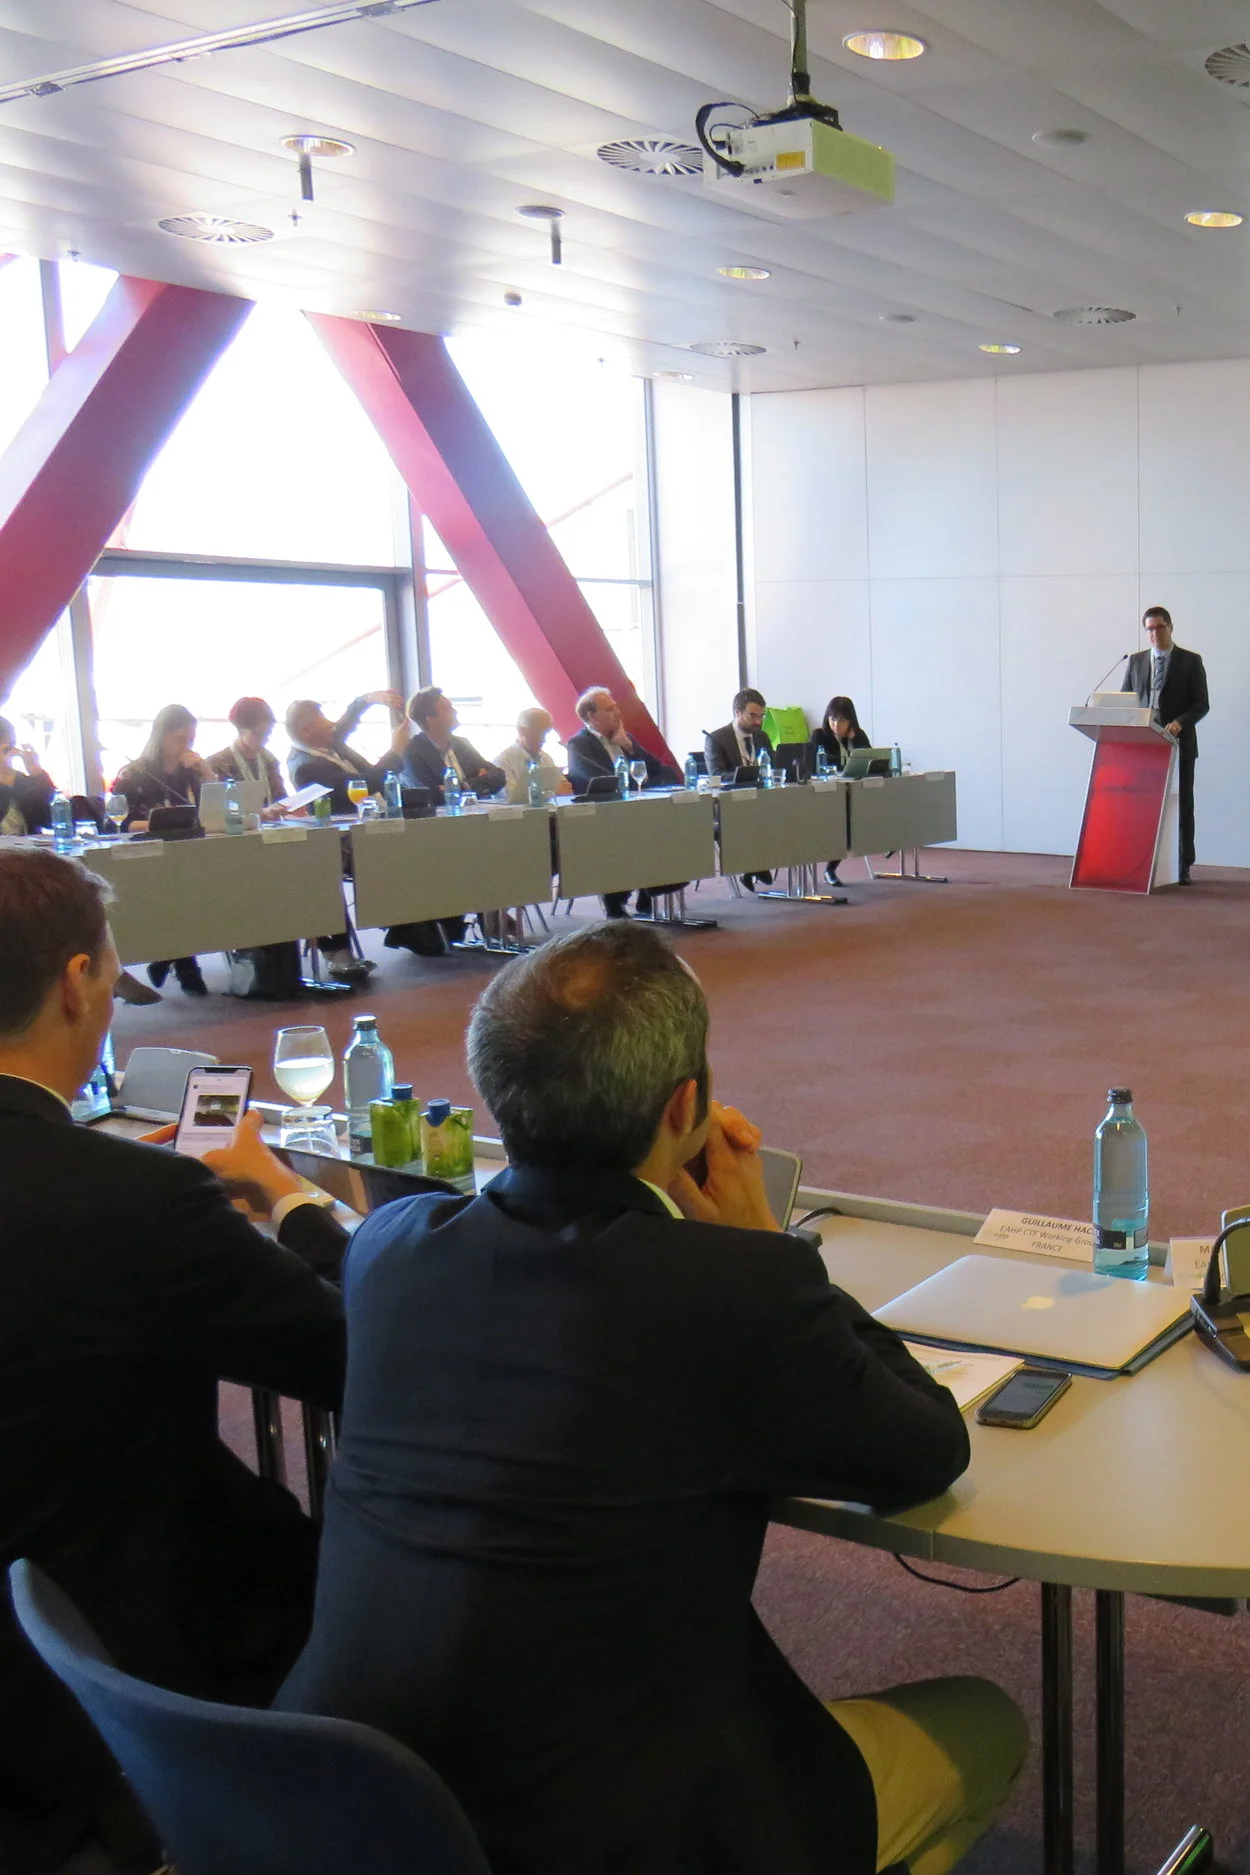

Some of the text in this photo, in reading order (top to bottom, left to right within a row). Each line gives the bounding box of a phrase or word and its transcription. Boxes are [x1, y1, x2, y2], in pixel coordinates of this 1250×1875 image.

[1000, 1225, 1023, 1235] EAHP
[1023, 1229, 1040, 1238] CTF
[1040, 1231, 1073, 1245] Working
[1074, 1237, 1094, 1247] Grou
[1021, 1217, 1094, 1236] GUILLAUME HAC
[1031, 1241, 1064, 1254] FRANCE
